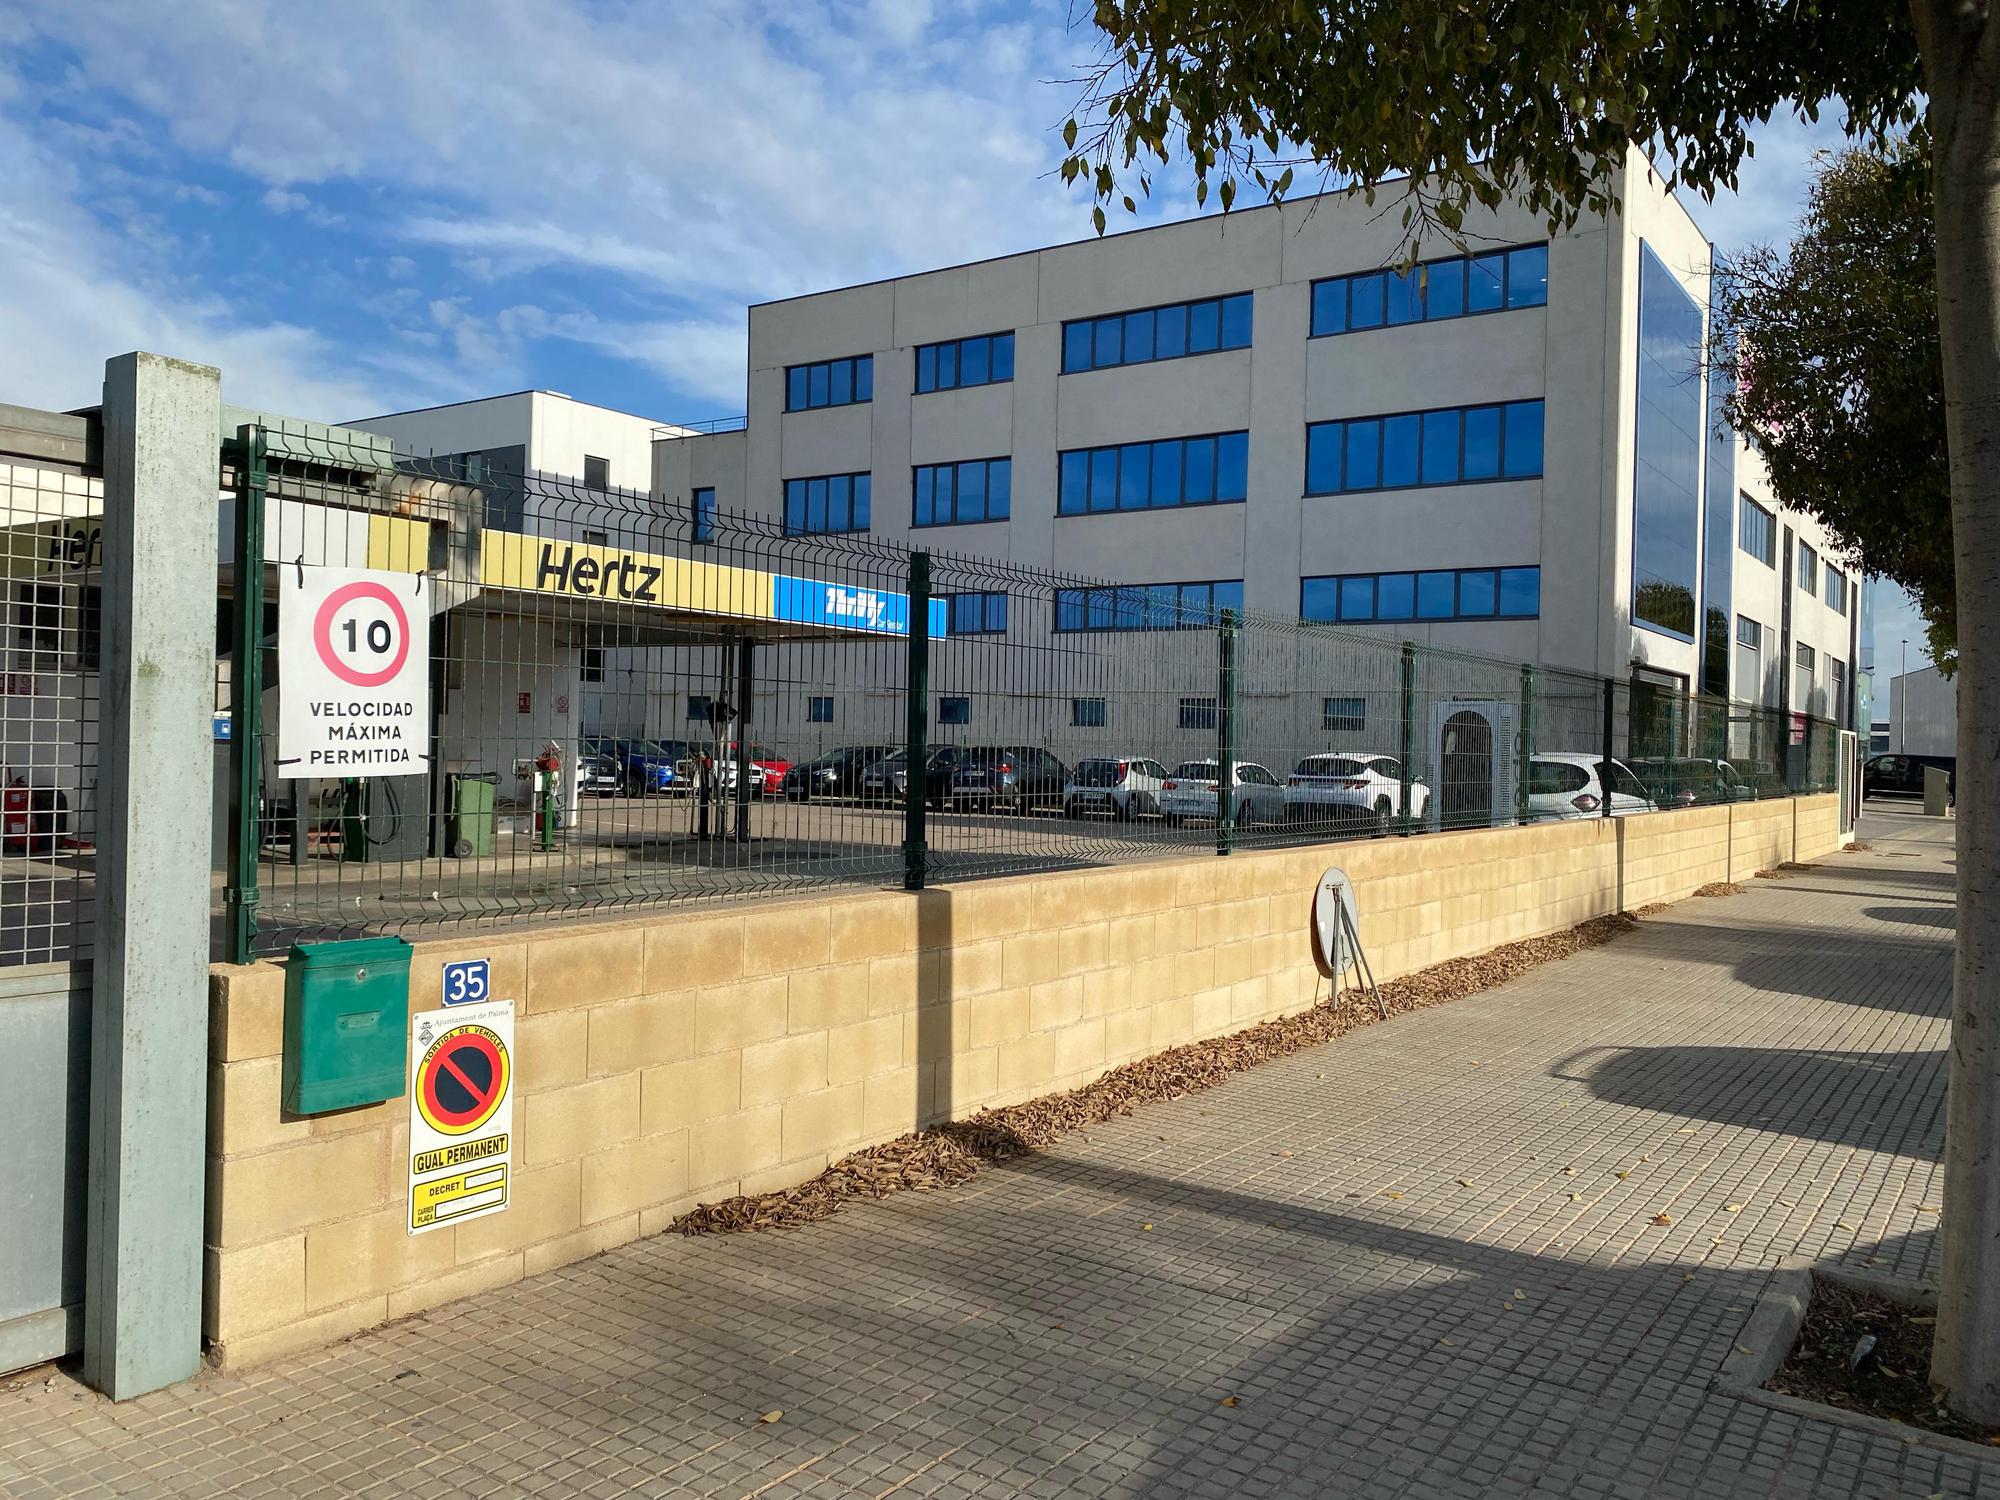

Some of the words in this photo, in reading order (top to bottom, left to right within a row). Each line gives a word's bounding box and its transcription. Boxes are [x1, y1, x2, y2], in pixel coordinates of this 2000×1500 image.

[47, 523, 102, 572] Her
[538, 543, 661, 601] Hertz
[826, 587, 886, 627] Thrifty
[342, 618, 391, 654] 10
[310, 702, 413, 717] VELOCIDAD
[328, 722, 402, 741] MÁXIMA
[310, 748, 410, 765] PERMITIDA
[449, 966, 484, 1001] 35
[434, 1015, 476, 1027] Ajuntament
[488, 1009, 509, 1017] Palma
[424, 1032, 454, 1064] SORTIDA
[475, 1028, 505, 1052] VEHICLES
[417, 1151, 444, 1171] GUAL
[447, 1137, 505, 1164] PERMANENT
[429, 1181, 461, 1197] DECRET
